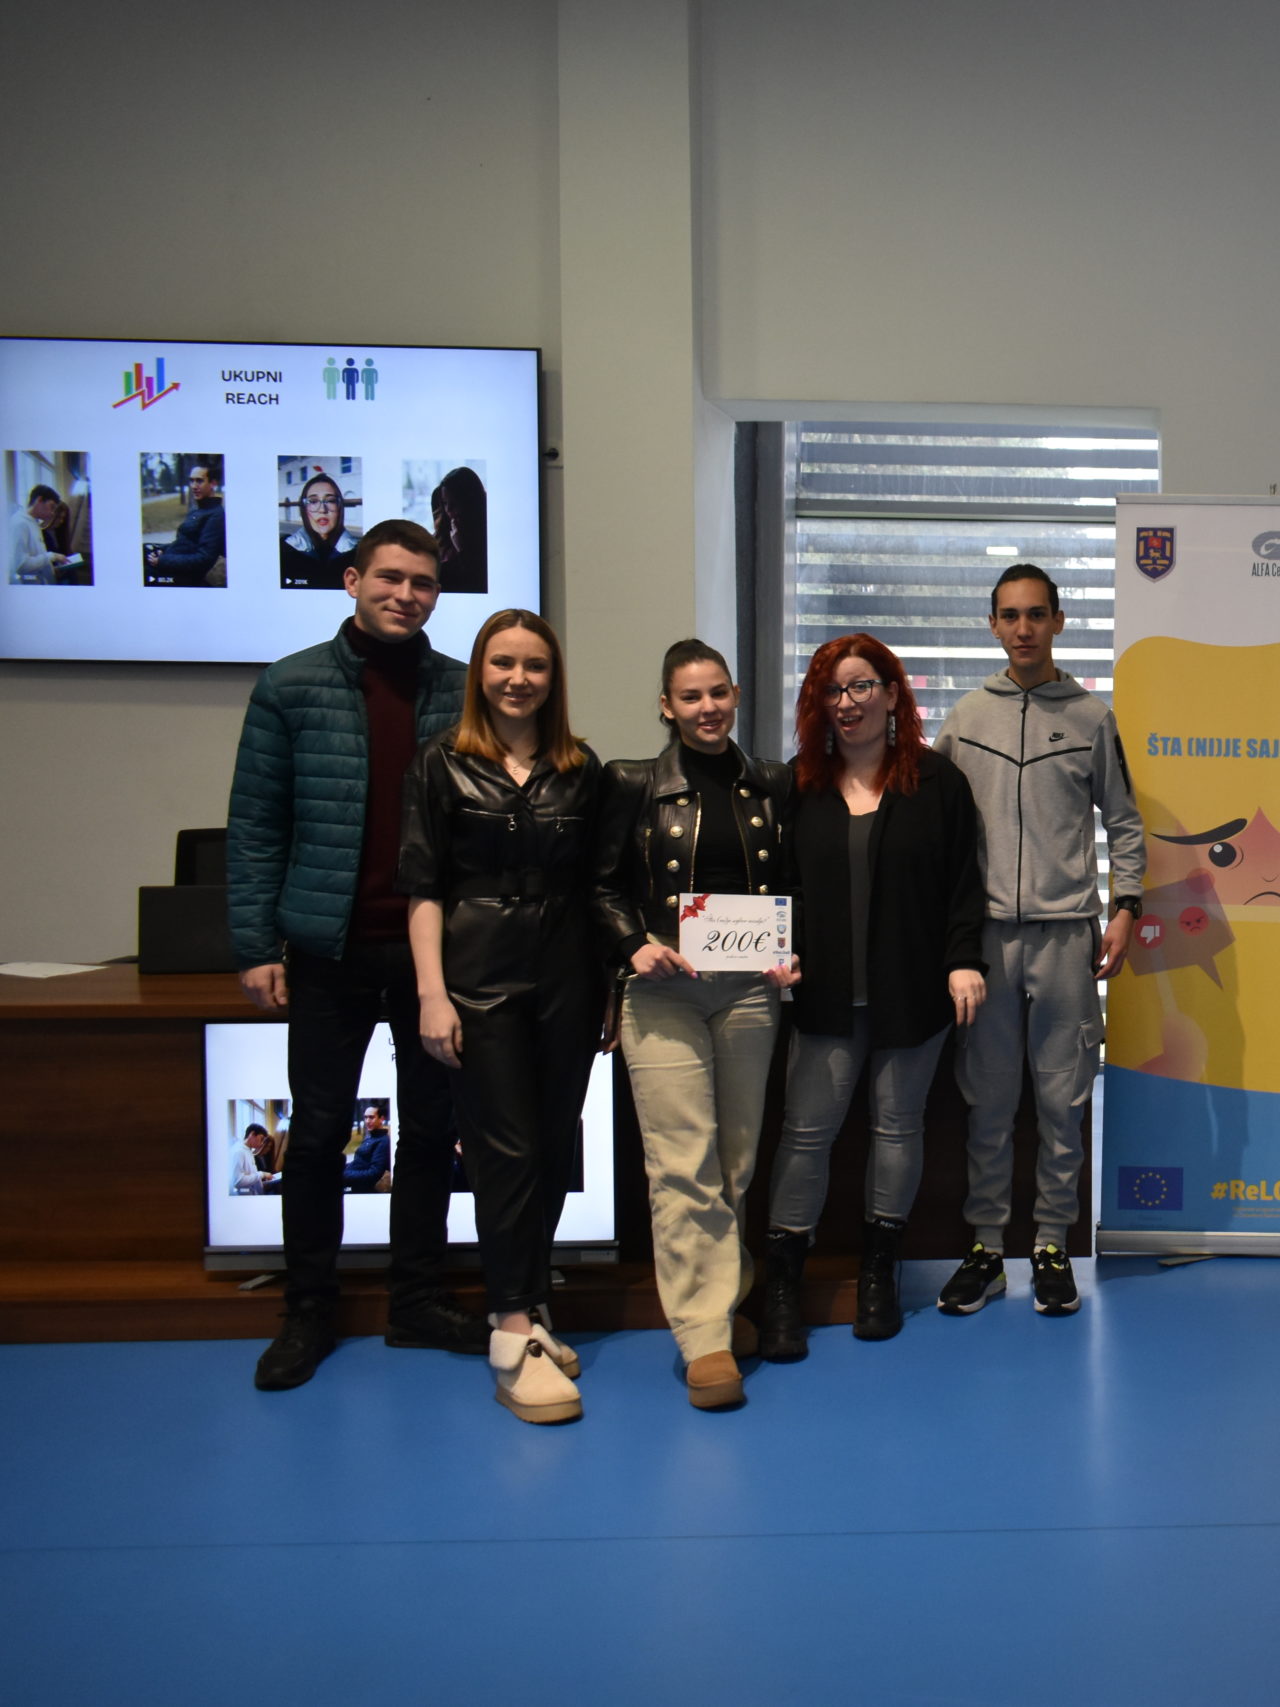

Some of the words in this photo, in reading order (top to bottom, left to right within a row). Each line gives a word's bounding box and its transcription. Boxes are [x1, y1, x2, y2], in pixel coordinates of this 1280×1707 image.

[221, 369, 283, 383] UKUPNI
[225, 392, 279, 405] REACH
[1251, 562, 1270, 577] ALFA
[1146, 732, 1183, 757] ŠTA
[701, 930, 771, 953] 200€
